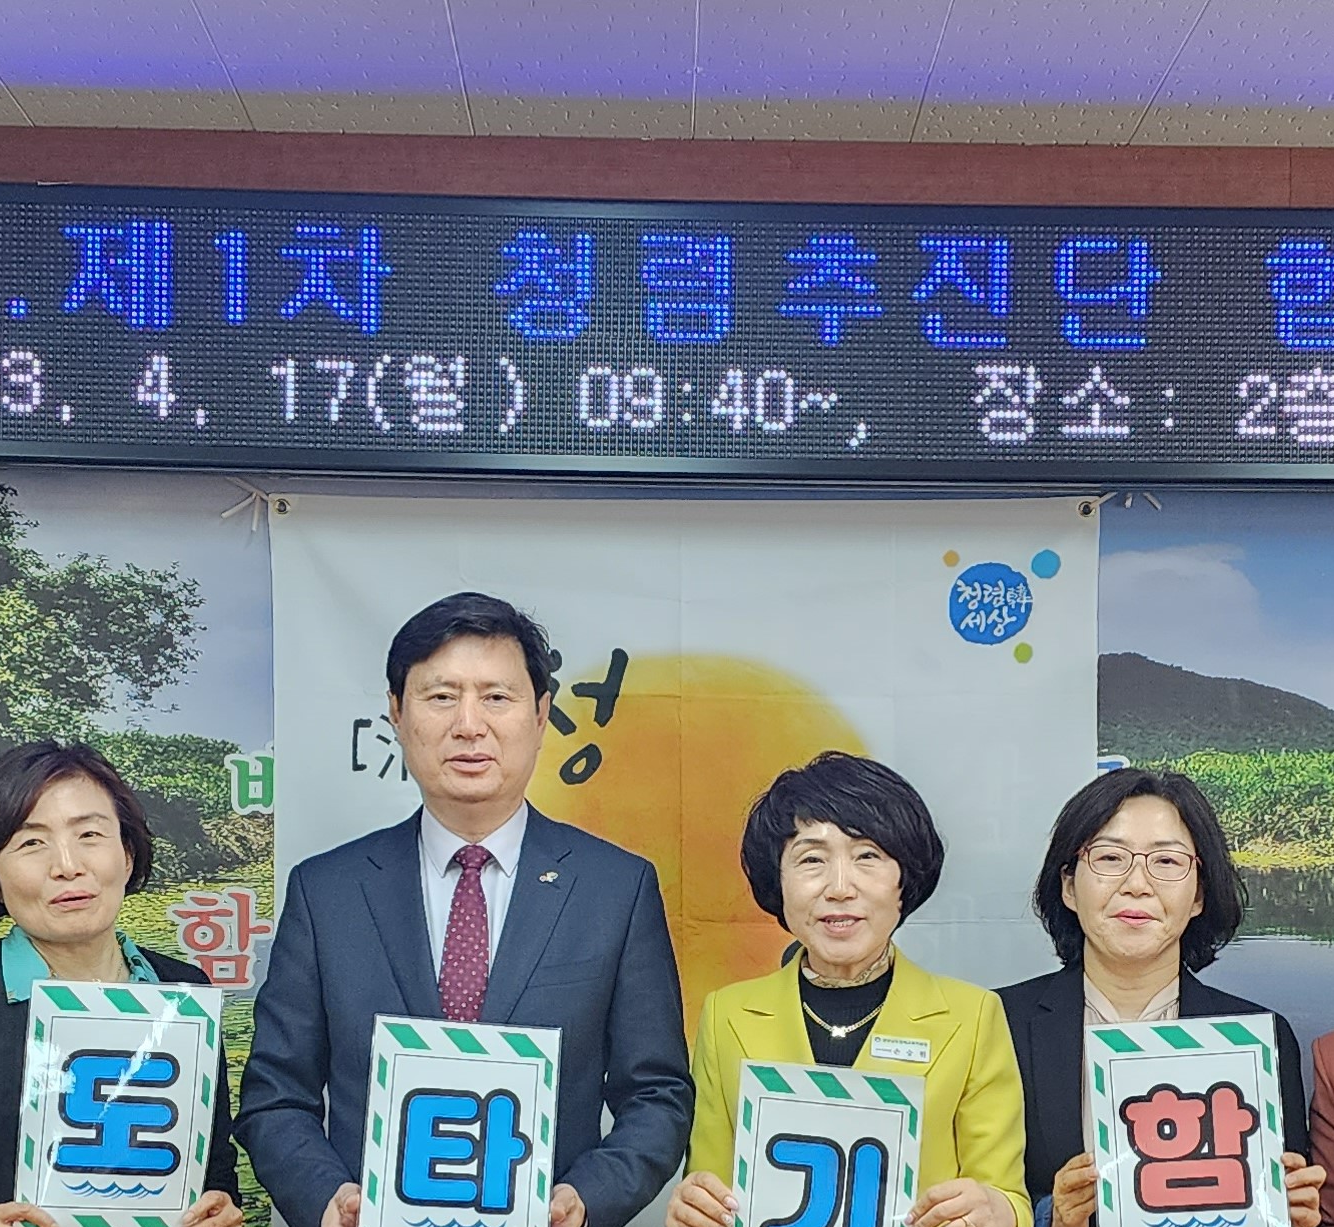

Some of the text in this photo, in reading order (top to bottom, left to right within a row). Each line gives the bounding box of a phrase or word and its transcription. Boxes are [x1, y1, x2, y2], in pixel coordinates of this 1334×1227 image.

[499, 230, 1163, 349] 청렴추진단
[271, 354, 524, 434] 17(월)
[975, 363, 1175, 442] 장소:
[959, 606, 1017, 637] 세상
[51, 1049, 181, 1175] 도
[394, 1087, 532, 1213] 타
[1119, 1081, 1260, 1213] 함
